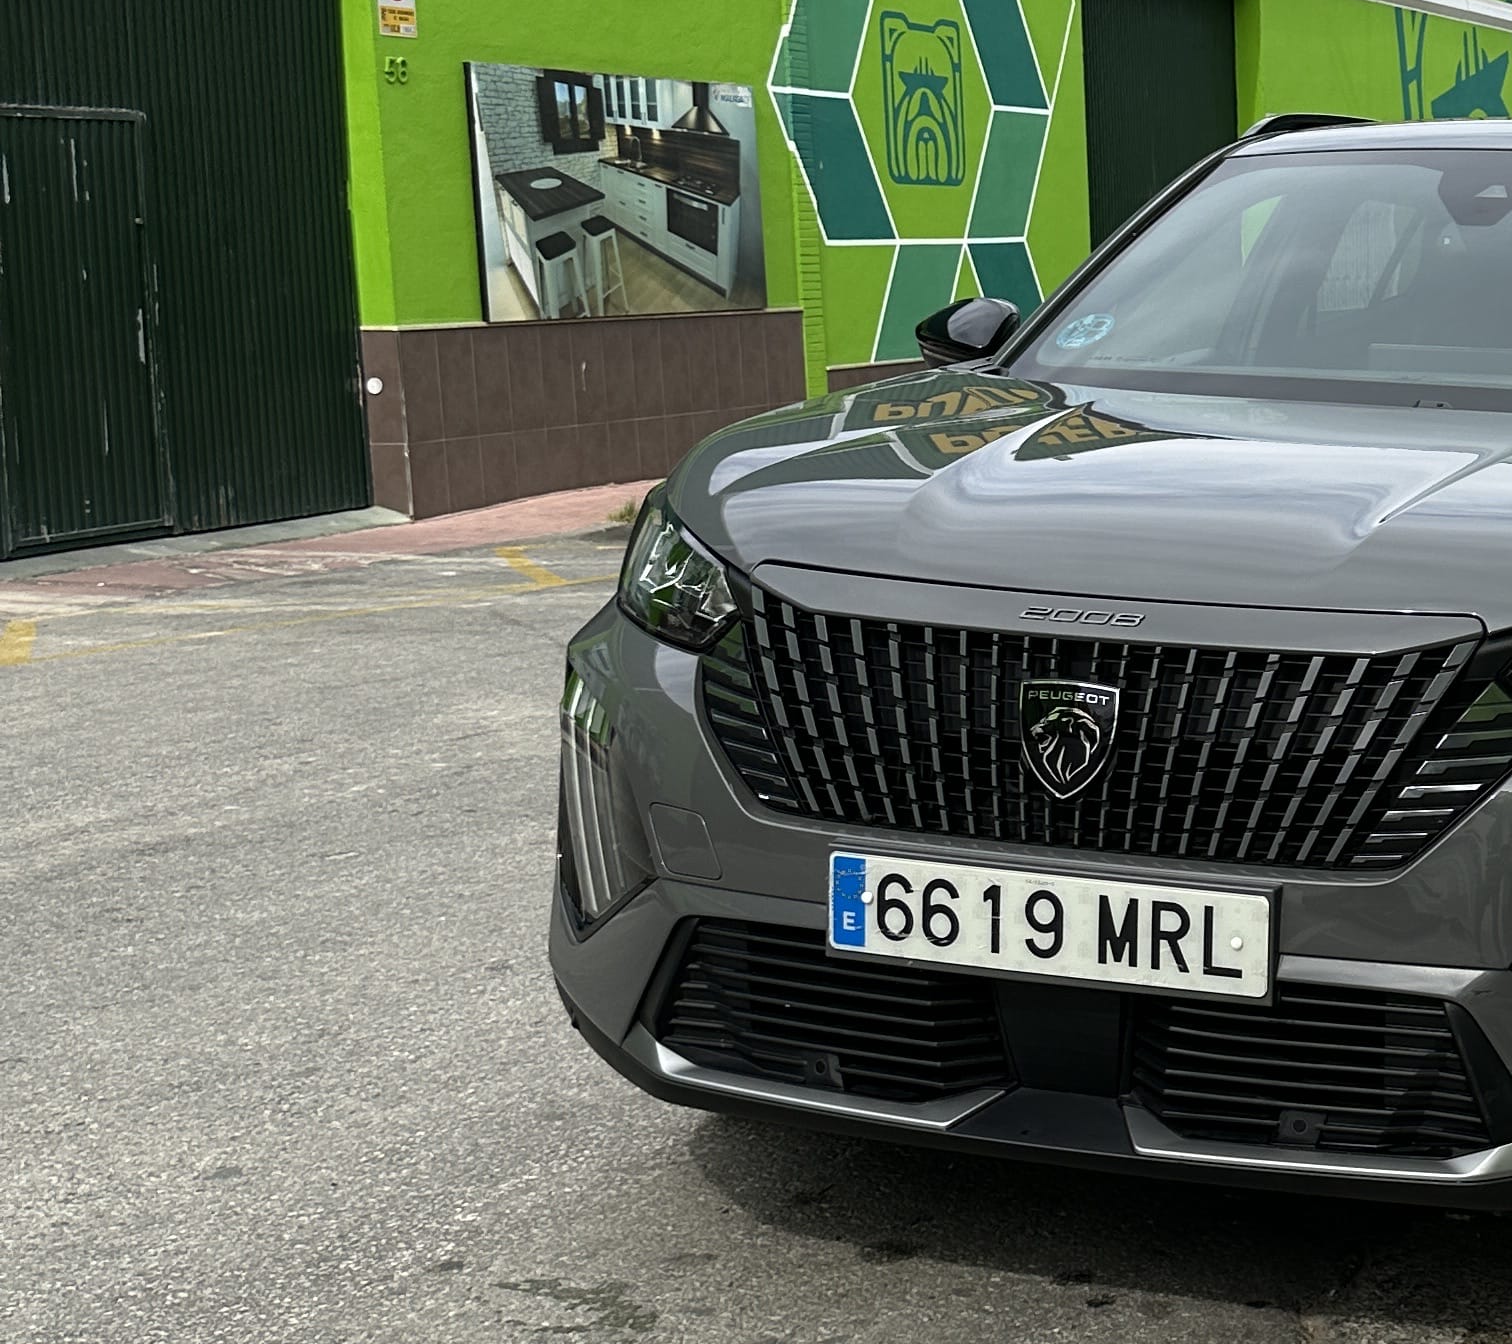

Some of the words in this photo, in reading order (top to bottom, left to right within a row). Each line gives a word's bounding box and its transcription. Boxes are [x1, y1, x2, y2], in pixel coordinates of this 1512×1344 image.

[1019, 606, 1145, 627] 2008
[1028, 690, 1110, 706] PEUGEOT
[842, 911, 856, 931] E
[876, 873, 1064, 959] 6619
[1098, 894, 1243, 980] MRL
